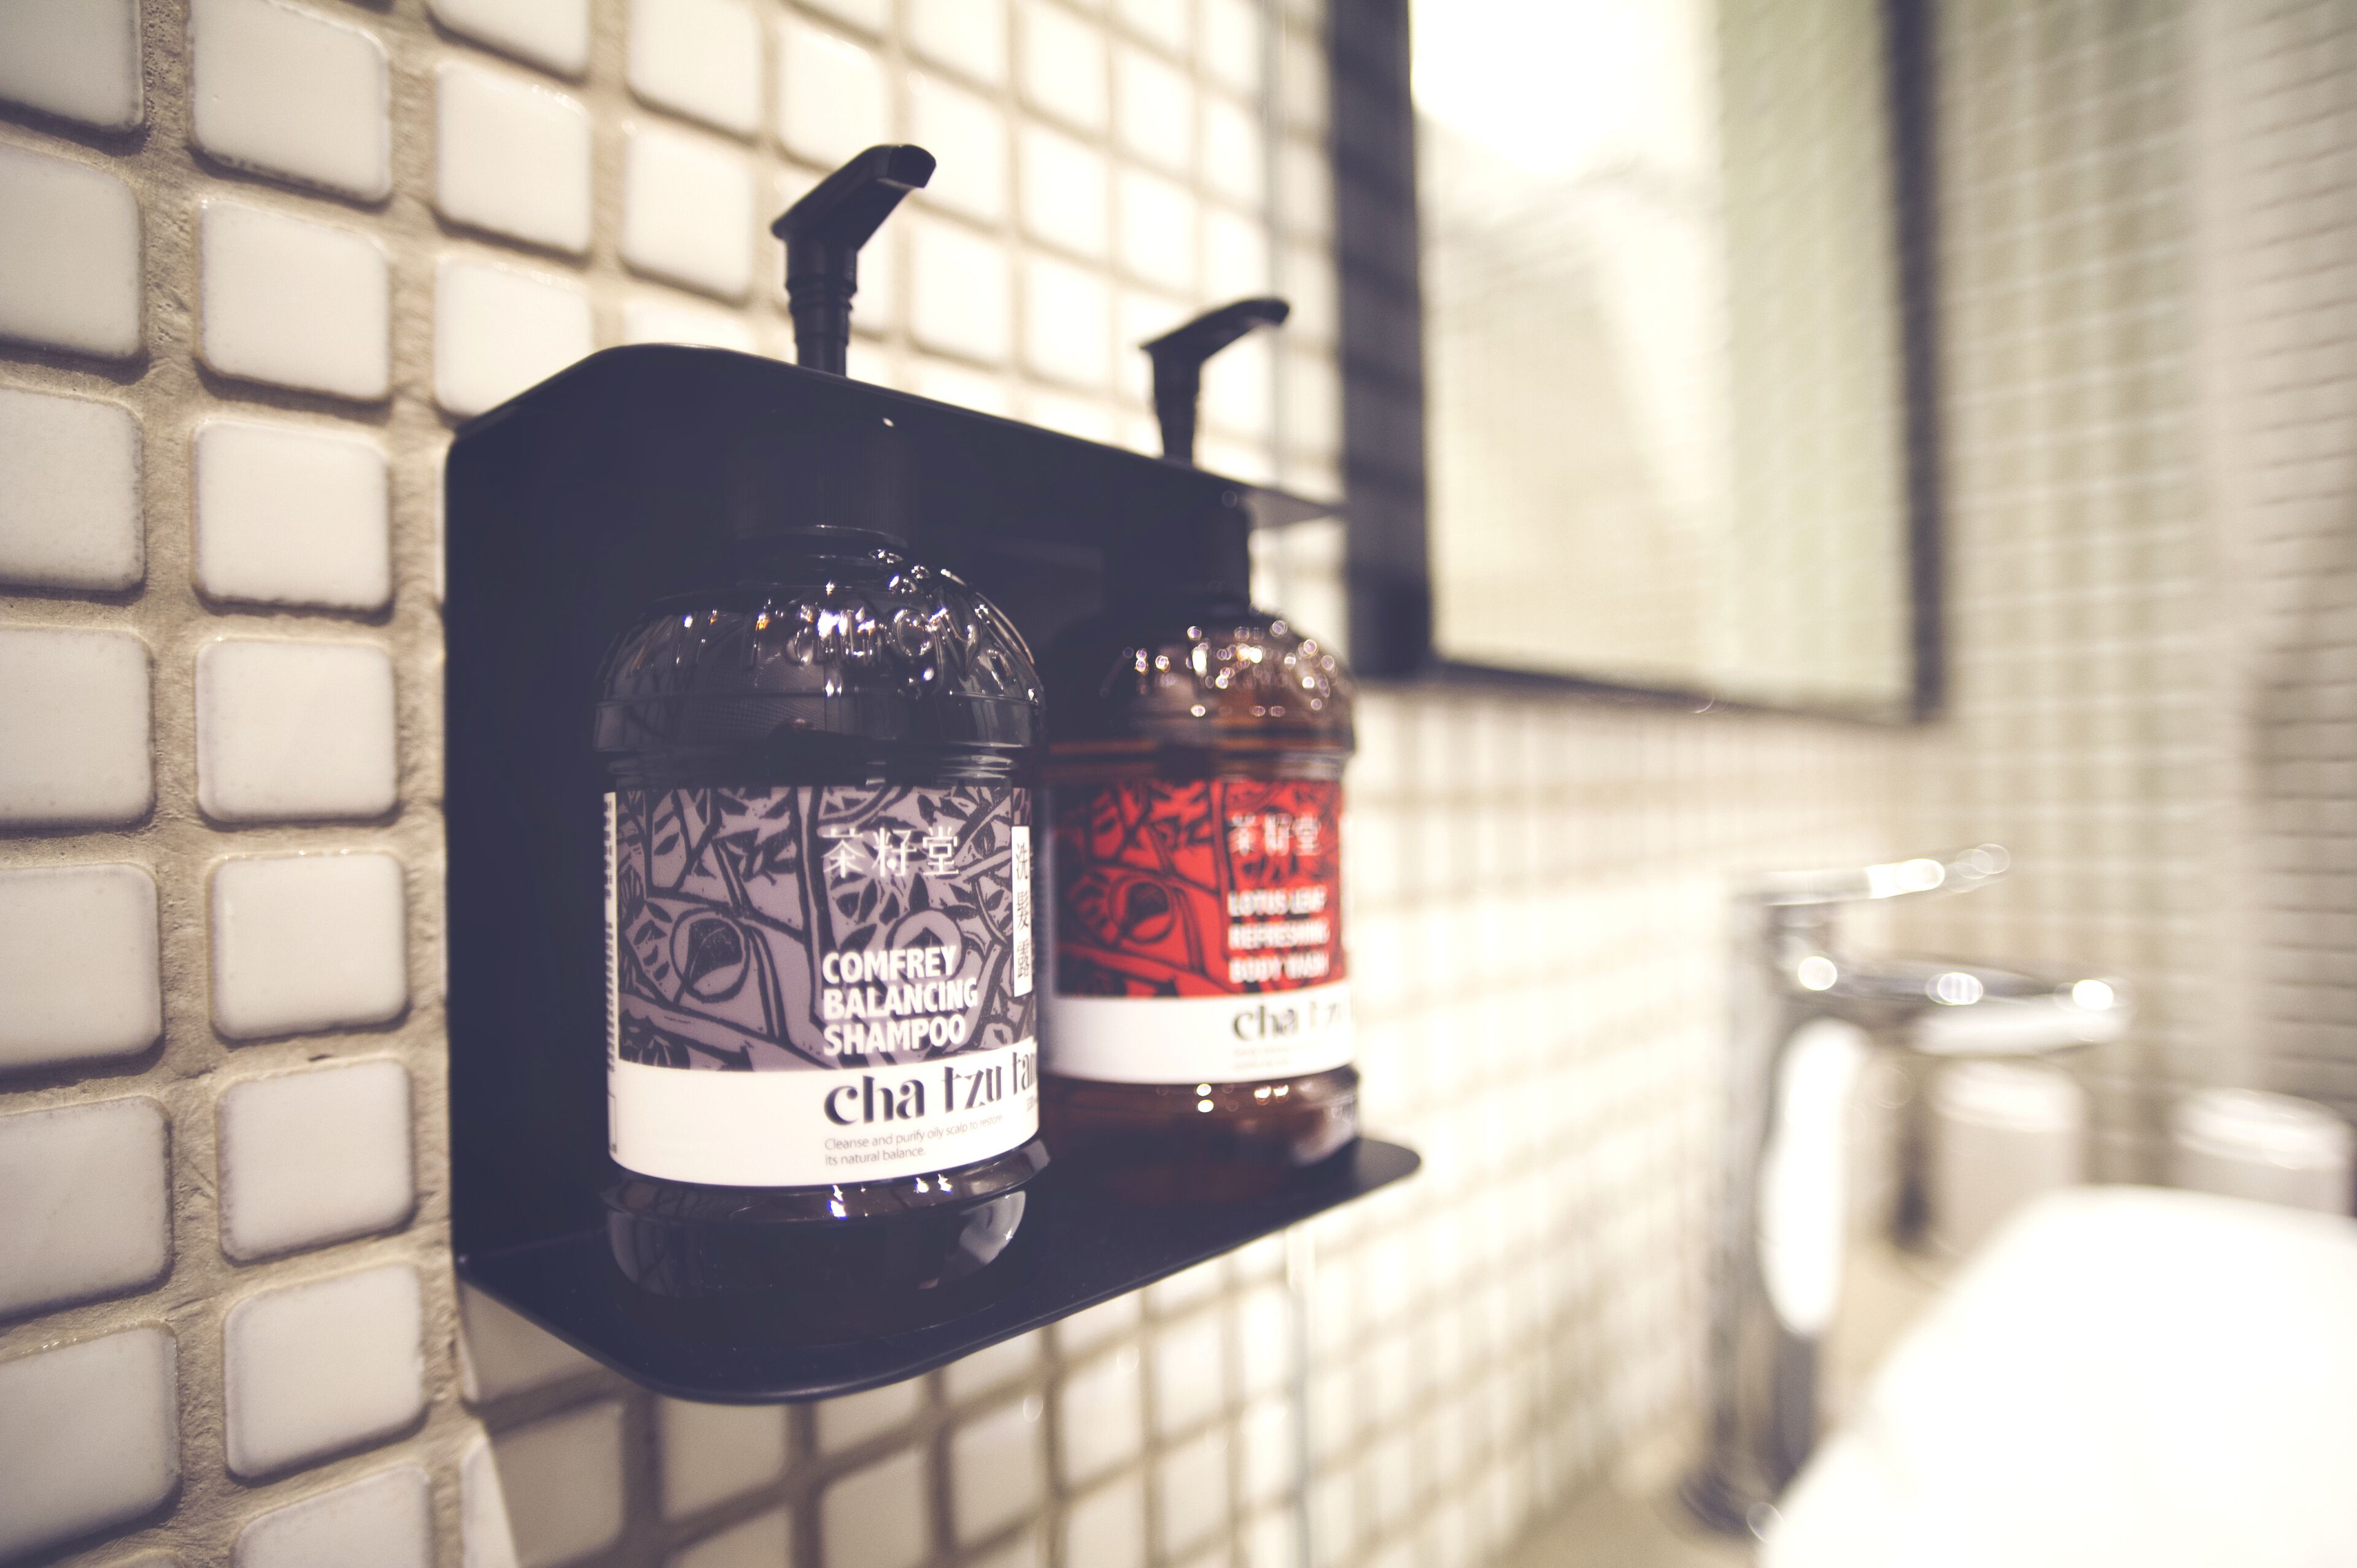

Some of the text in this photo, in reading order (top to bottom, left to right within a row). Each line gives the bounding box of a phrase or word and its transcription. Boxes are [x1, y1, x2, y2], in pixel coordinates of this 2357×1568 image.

[821, 827, 959, 878] 茶籽堂
[1015, 841, 1029, 979] 洗髮露
[822, 946, 956, 984] COMFREY
[824, 978, 978, 1020] BALANCING
[823, 1014, 966, 1056] SHAMPOO
[824, 1075, 925, 1126] cha
[941, 1065, 1002, 1113] tzu
[825, 1114, 1002, 1150] Cleanse and purify oily scalp to restore
[825, 1147, 926, 1166] its natural balance.
